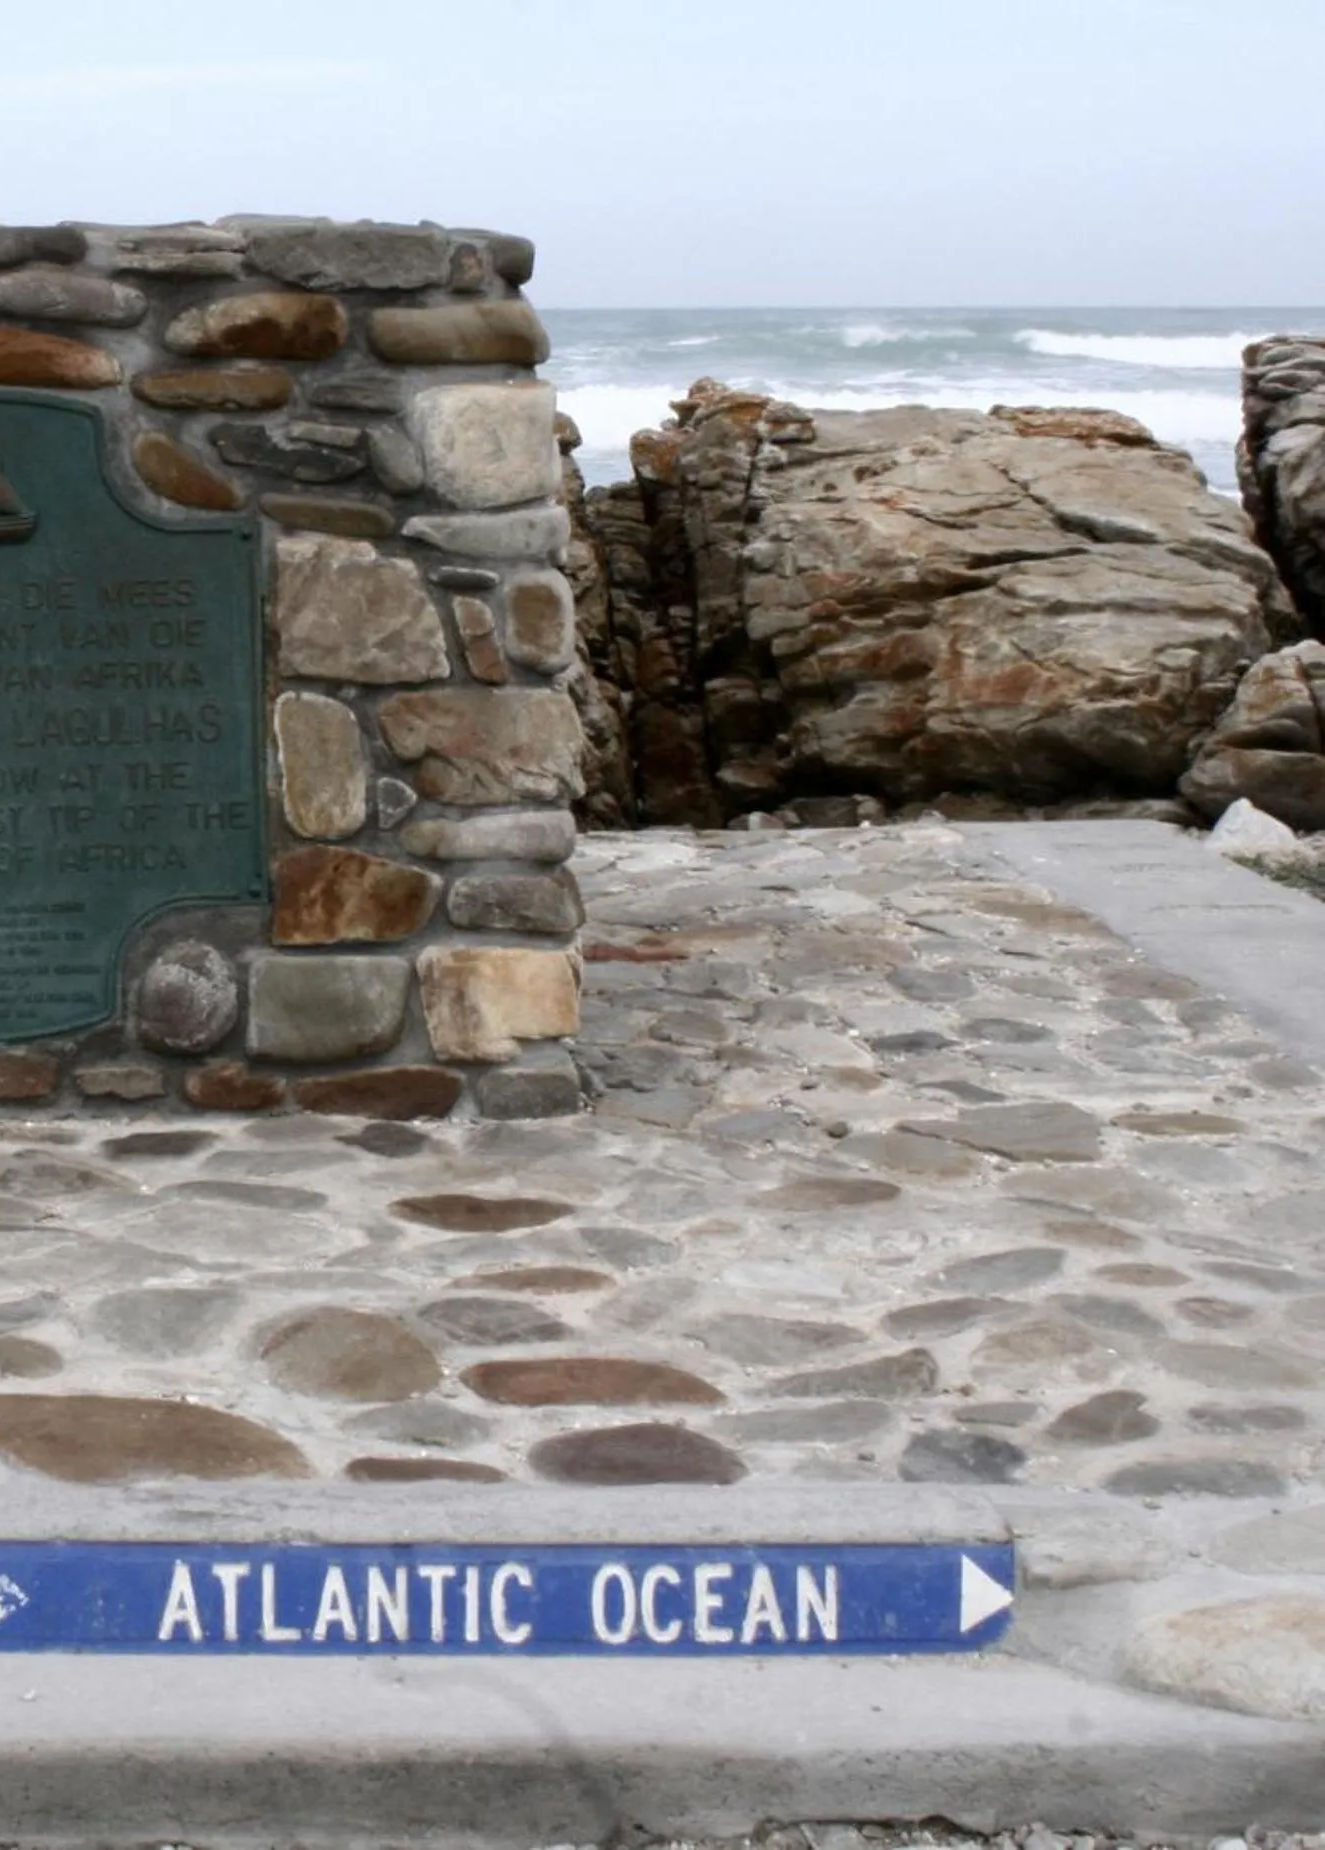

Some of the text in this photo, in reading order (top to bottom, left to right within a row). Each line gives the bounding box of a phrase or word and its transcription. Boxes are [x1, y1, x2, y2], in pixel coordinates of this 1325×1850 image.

[20, 578, 77, 611] DIE
[150, 616, 206, 648] DIE
[73, 660, 205, 690] AFRIKA
[59, 763, 103, 793] AT
[123, 761, 191, 791] THE
[48, 803, 94, 835] TIP
[120, 802, 162, 833] OF
[185, 800, 251, 831] THE
[58, 842, 188, 875] AFRICA
[158, 1560, 839, 1645] ATLANTIC OCEAN
